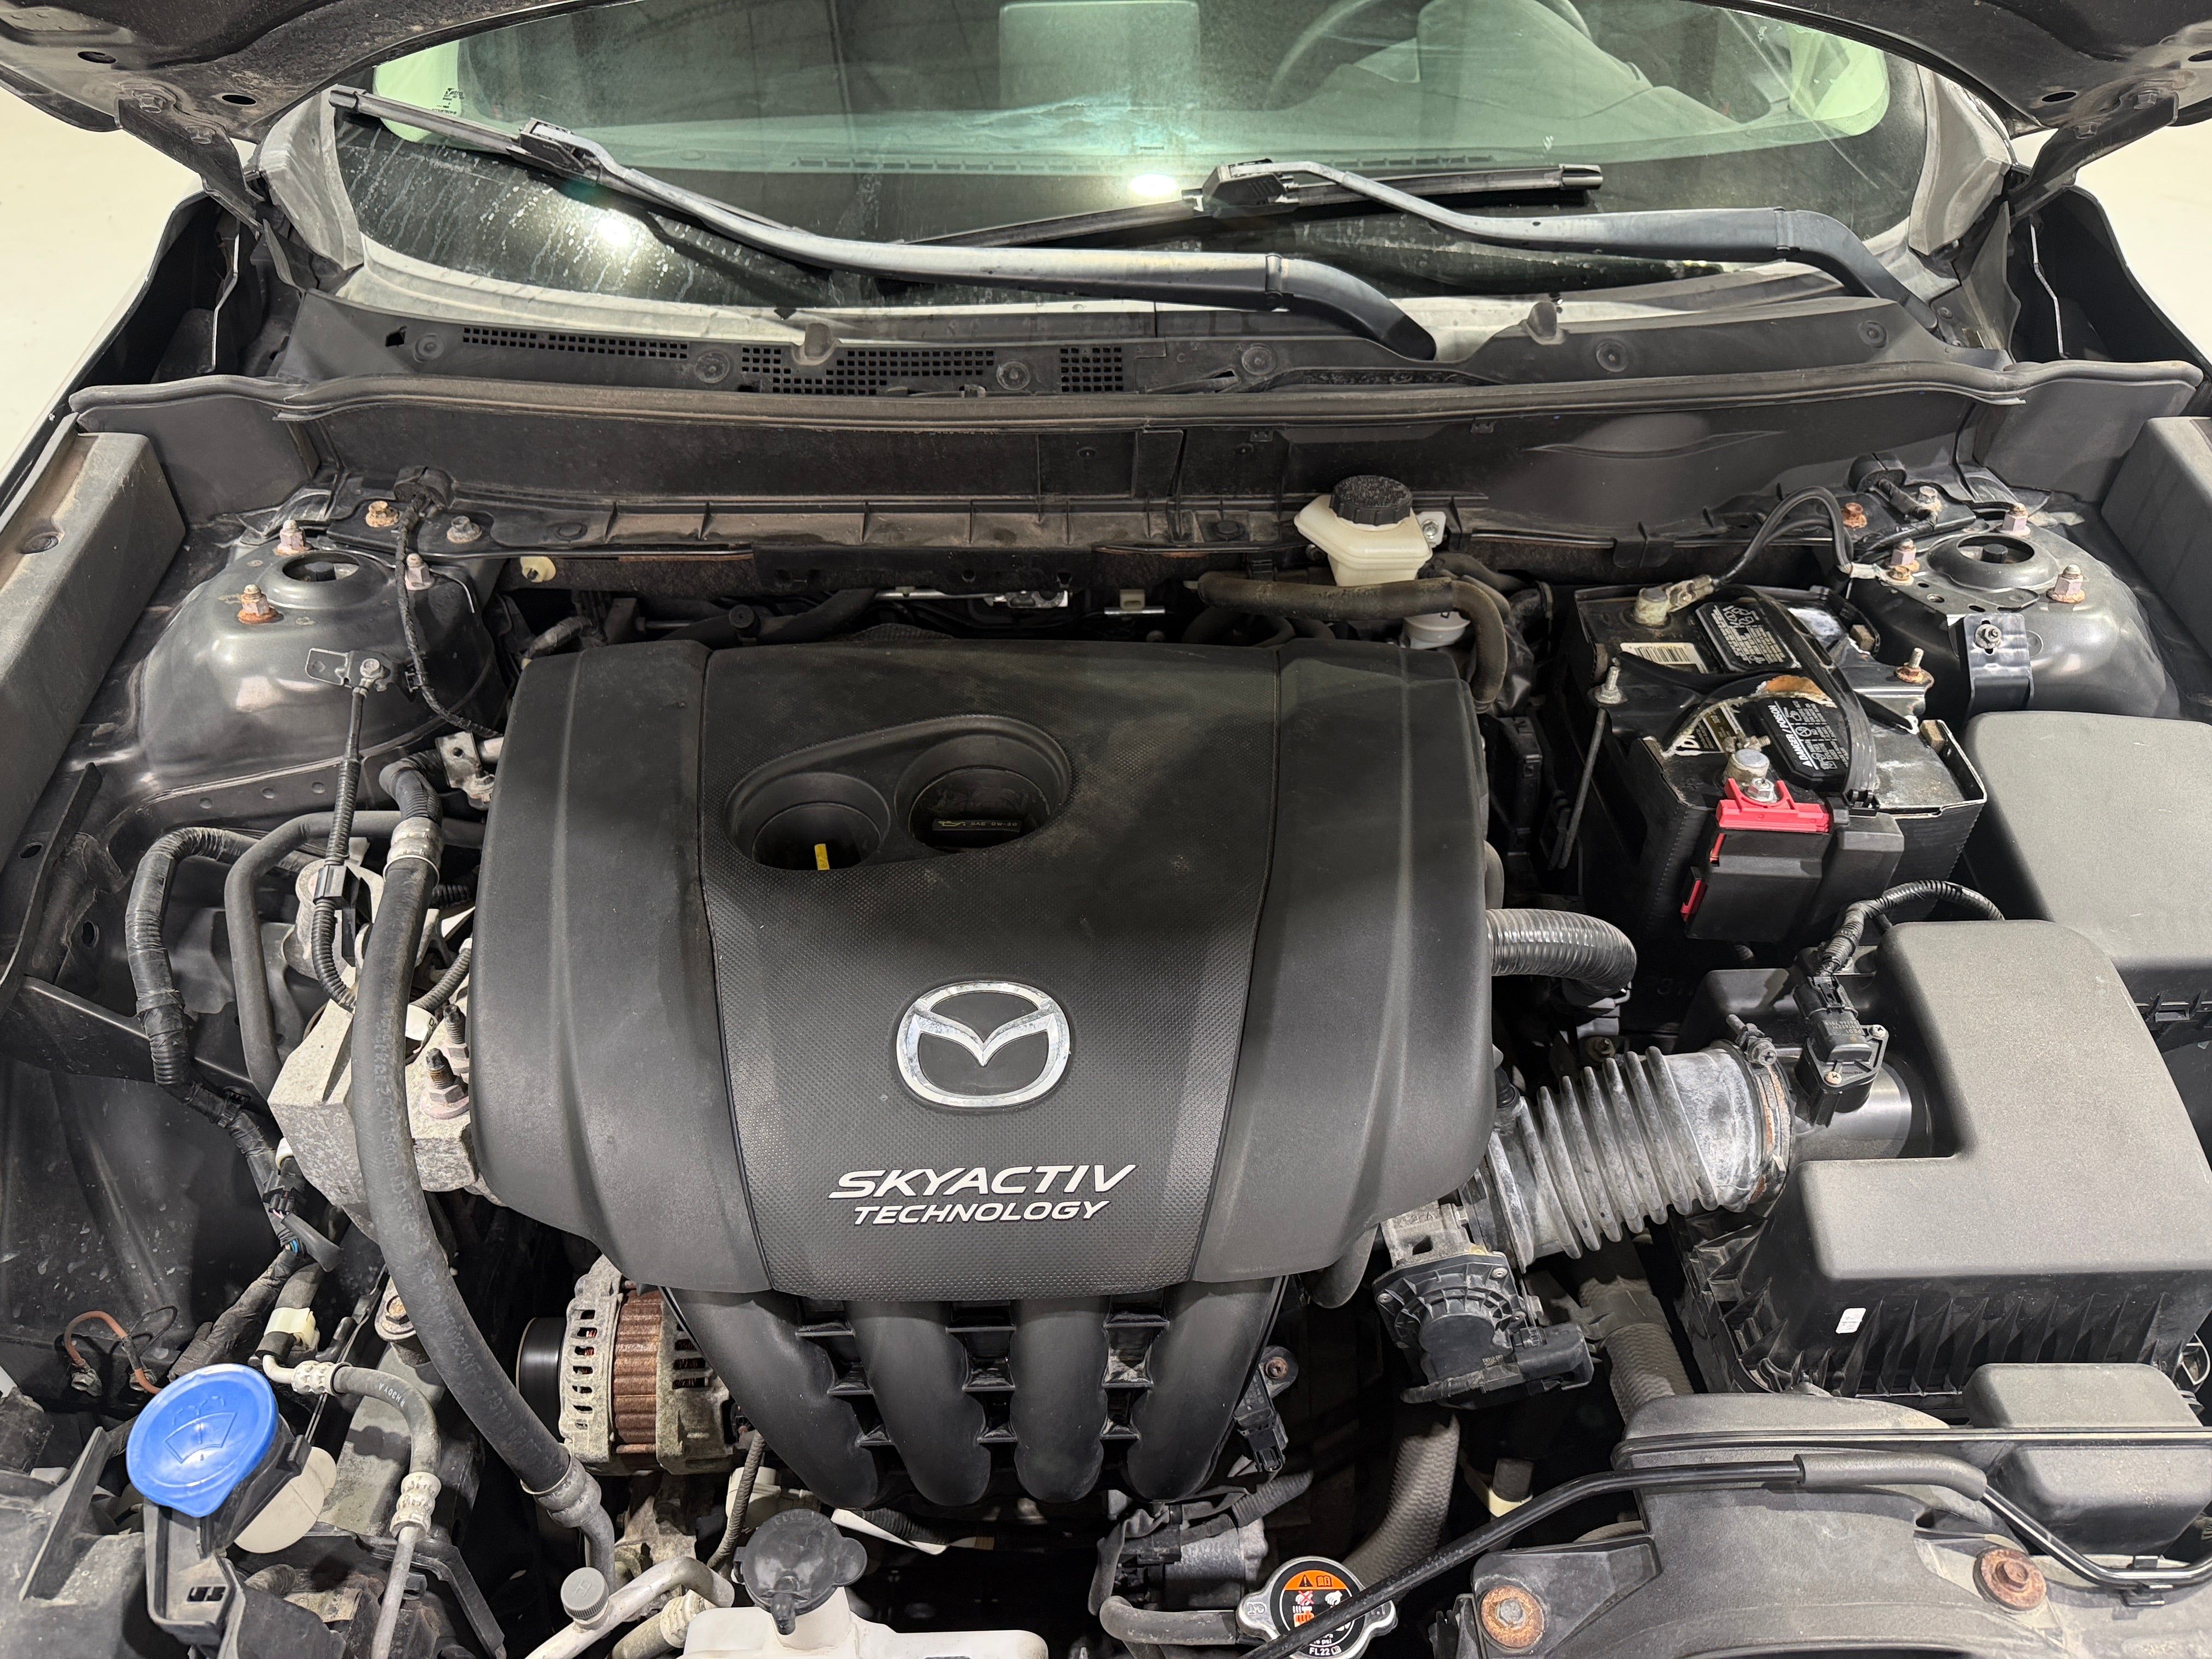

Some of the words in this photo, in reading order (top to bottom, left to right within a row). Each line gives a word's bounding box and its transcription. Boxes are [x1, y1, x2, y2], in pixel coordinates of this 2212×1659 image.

[1768, 704, 1789, 729] POISON
[1785, 733, 1807, 761] DANGER
[828, 1164, 1136, 1199] SKYACTIV
[854, 1200, 1110, 1224] TECHNOLOGY
[1309, 1647, 1330, 1656] FL22
